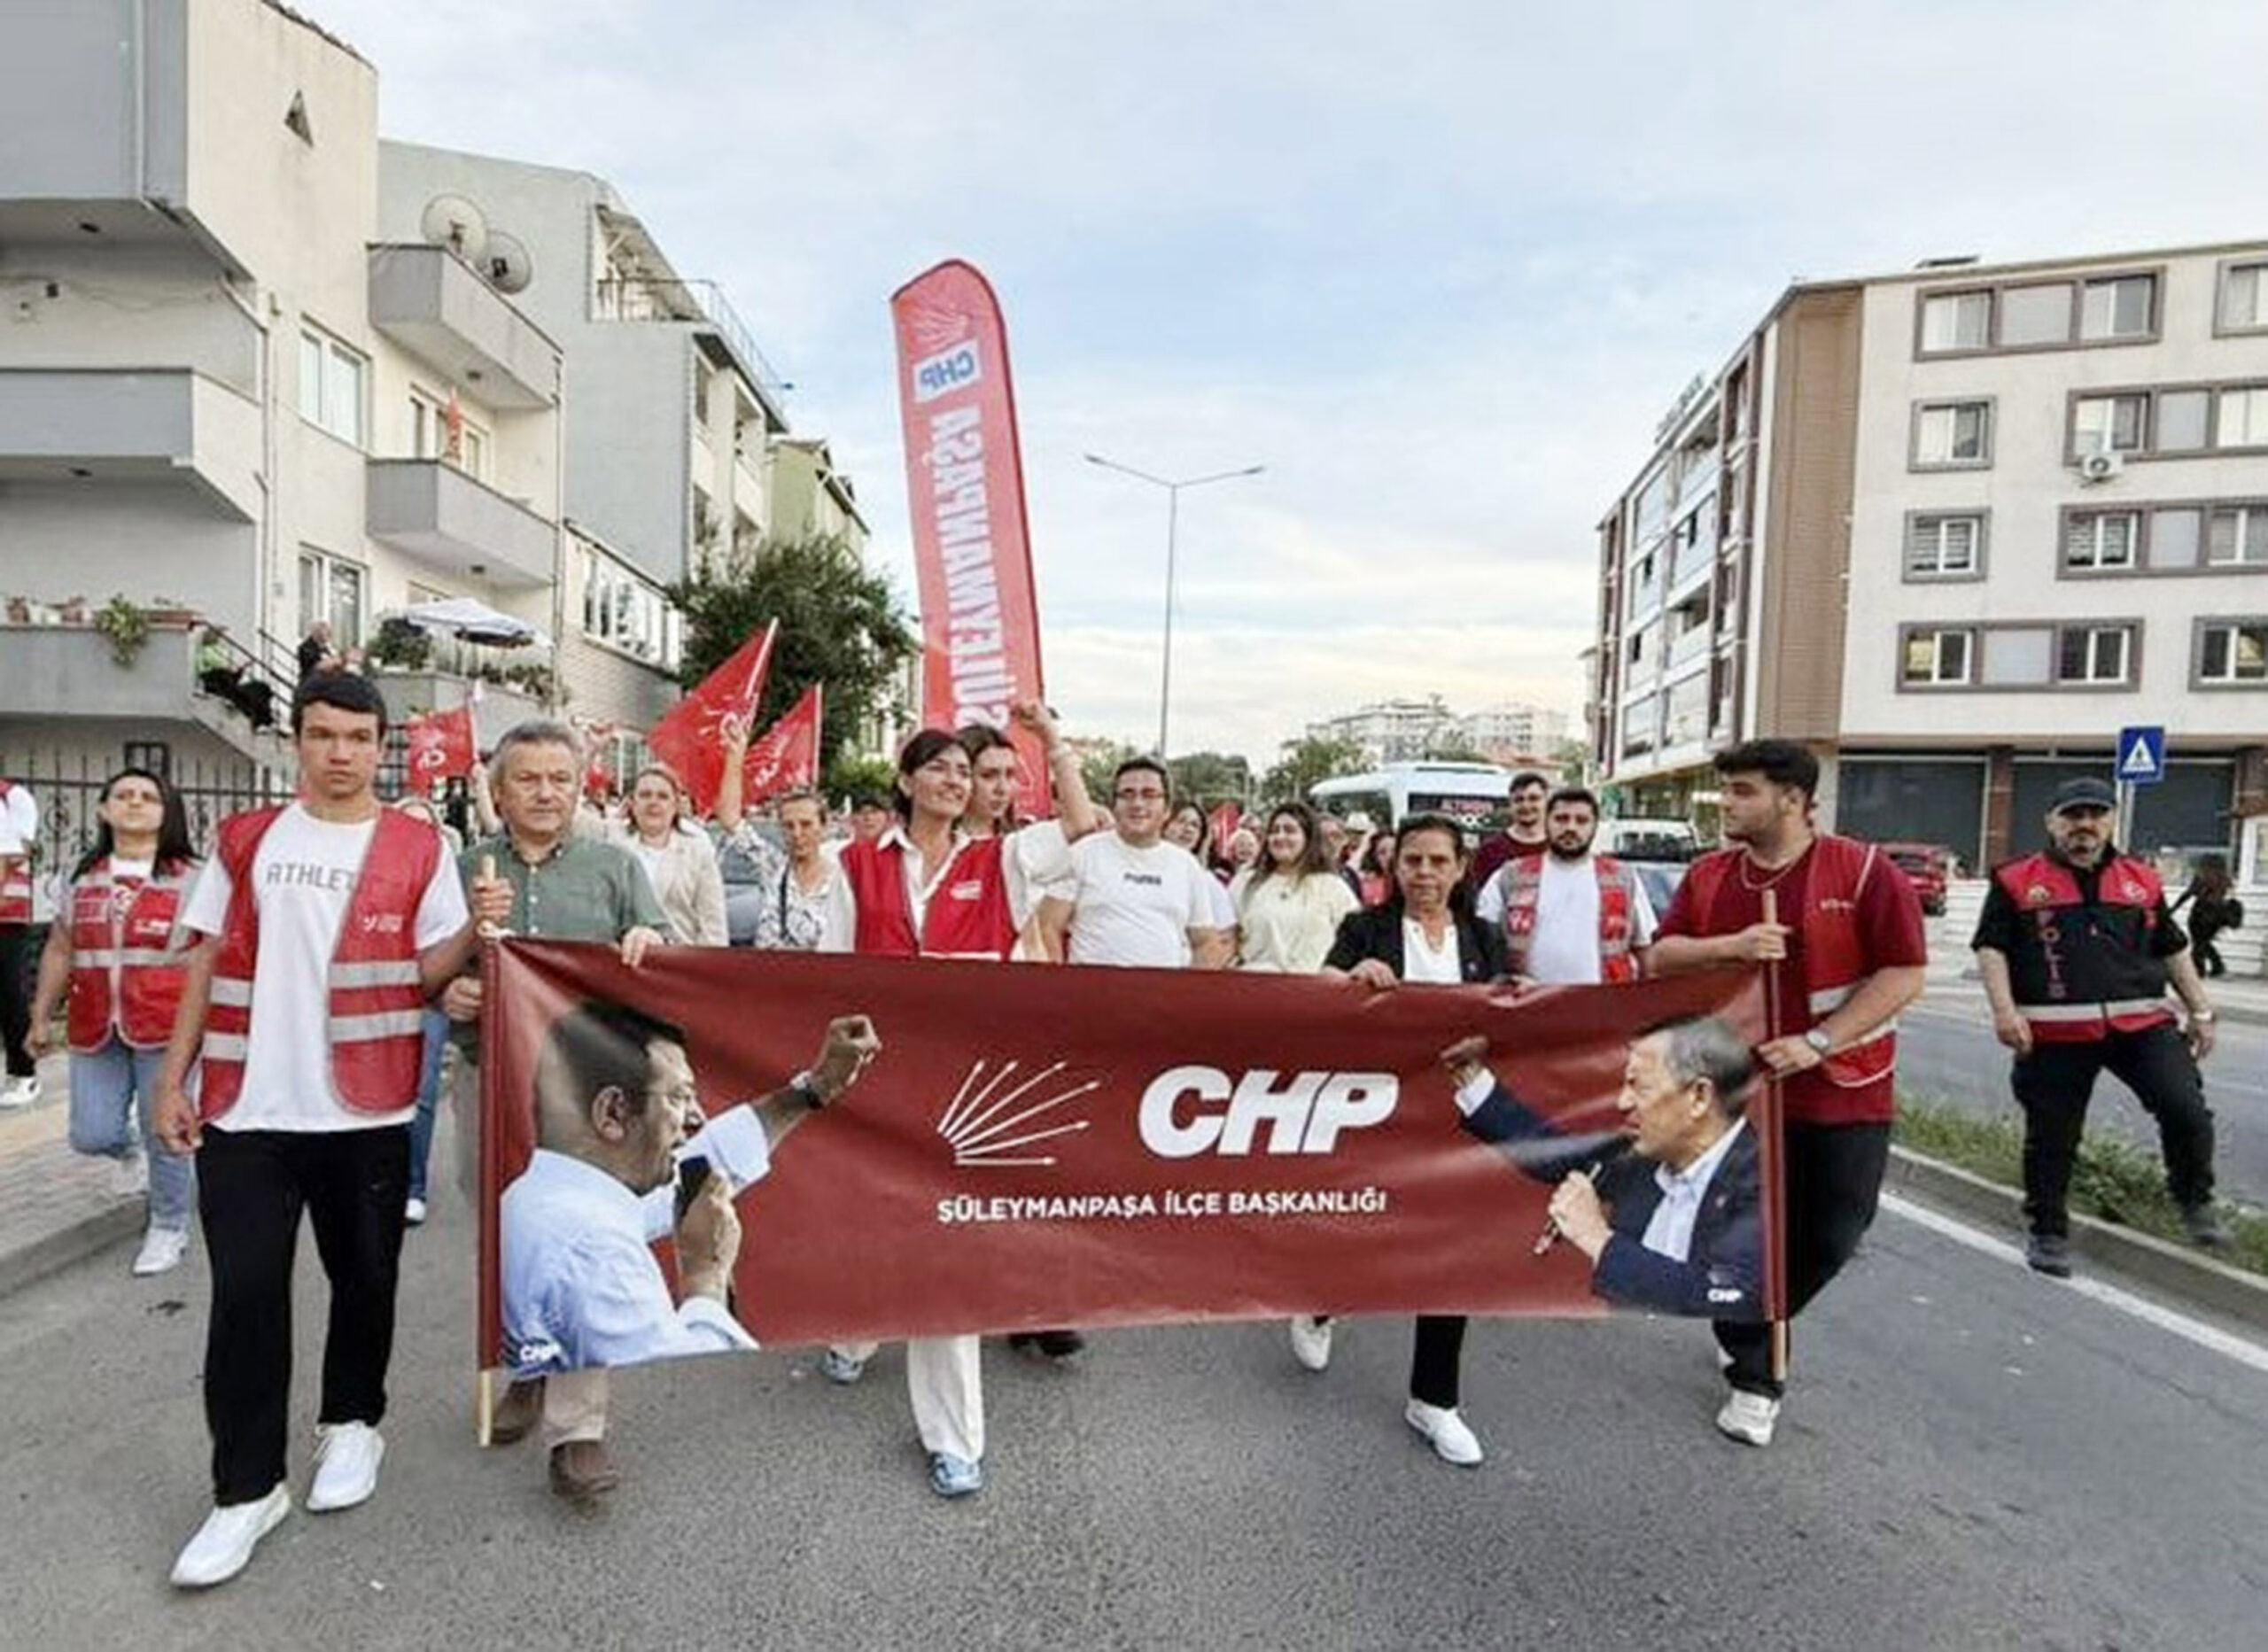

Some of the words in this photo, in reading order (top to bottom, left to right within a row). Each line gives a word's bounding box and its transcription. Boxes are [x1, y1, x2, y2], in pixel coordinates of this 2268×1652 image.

[1139, 1065, 1401, 1158] CHP
[936, 1193, 1157, 1223] SÜLEYMANPAŞA
[1164, 1191, 1222, 1217] İLÇE
[1229, 1186, 1387, 1218] BAŞKANLIĞI
